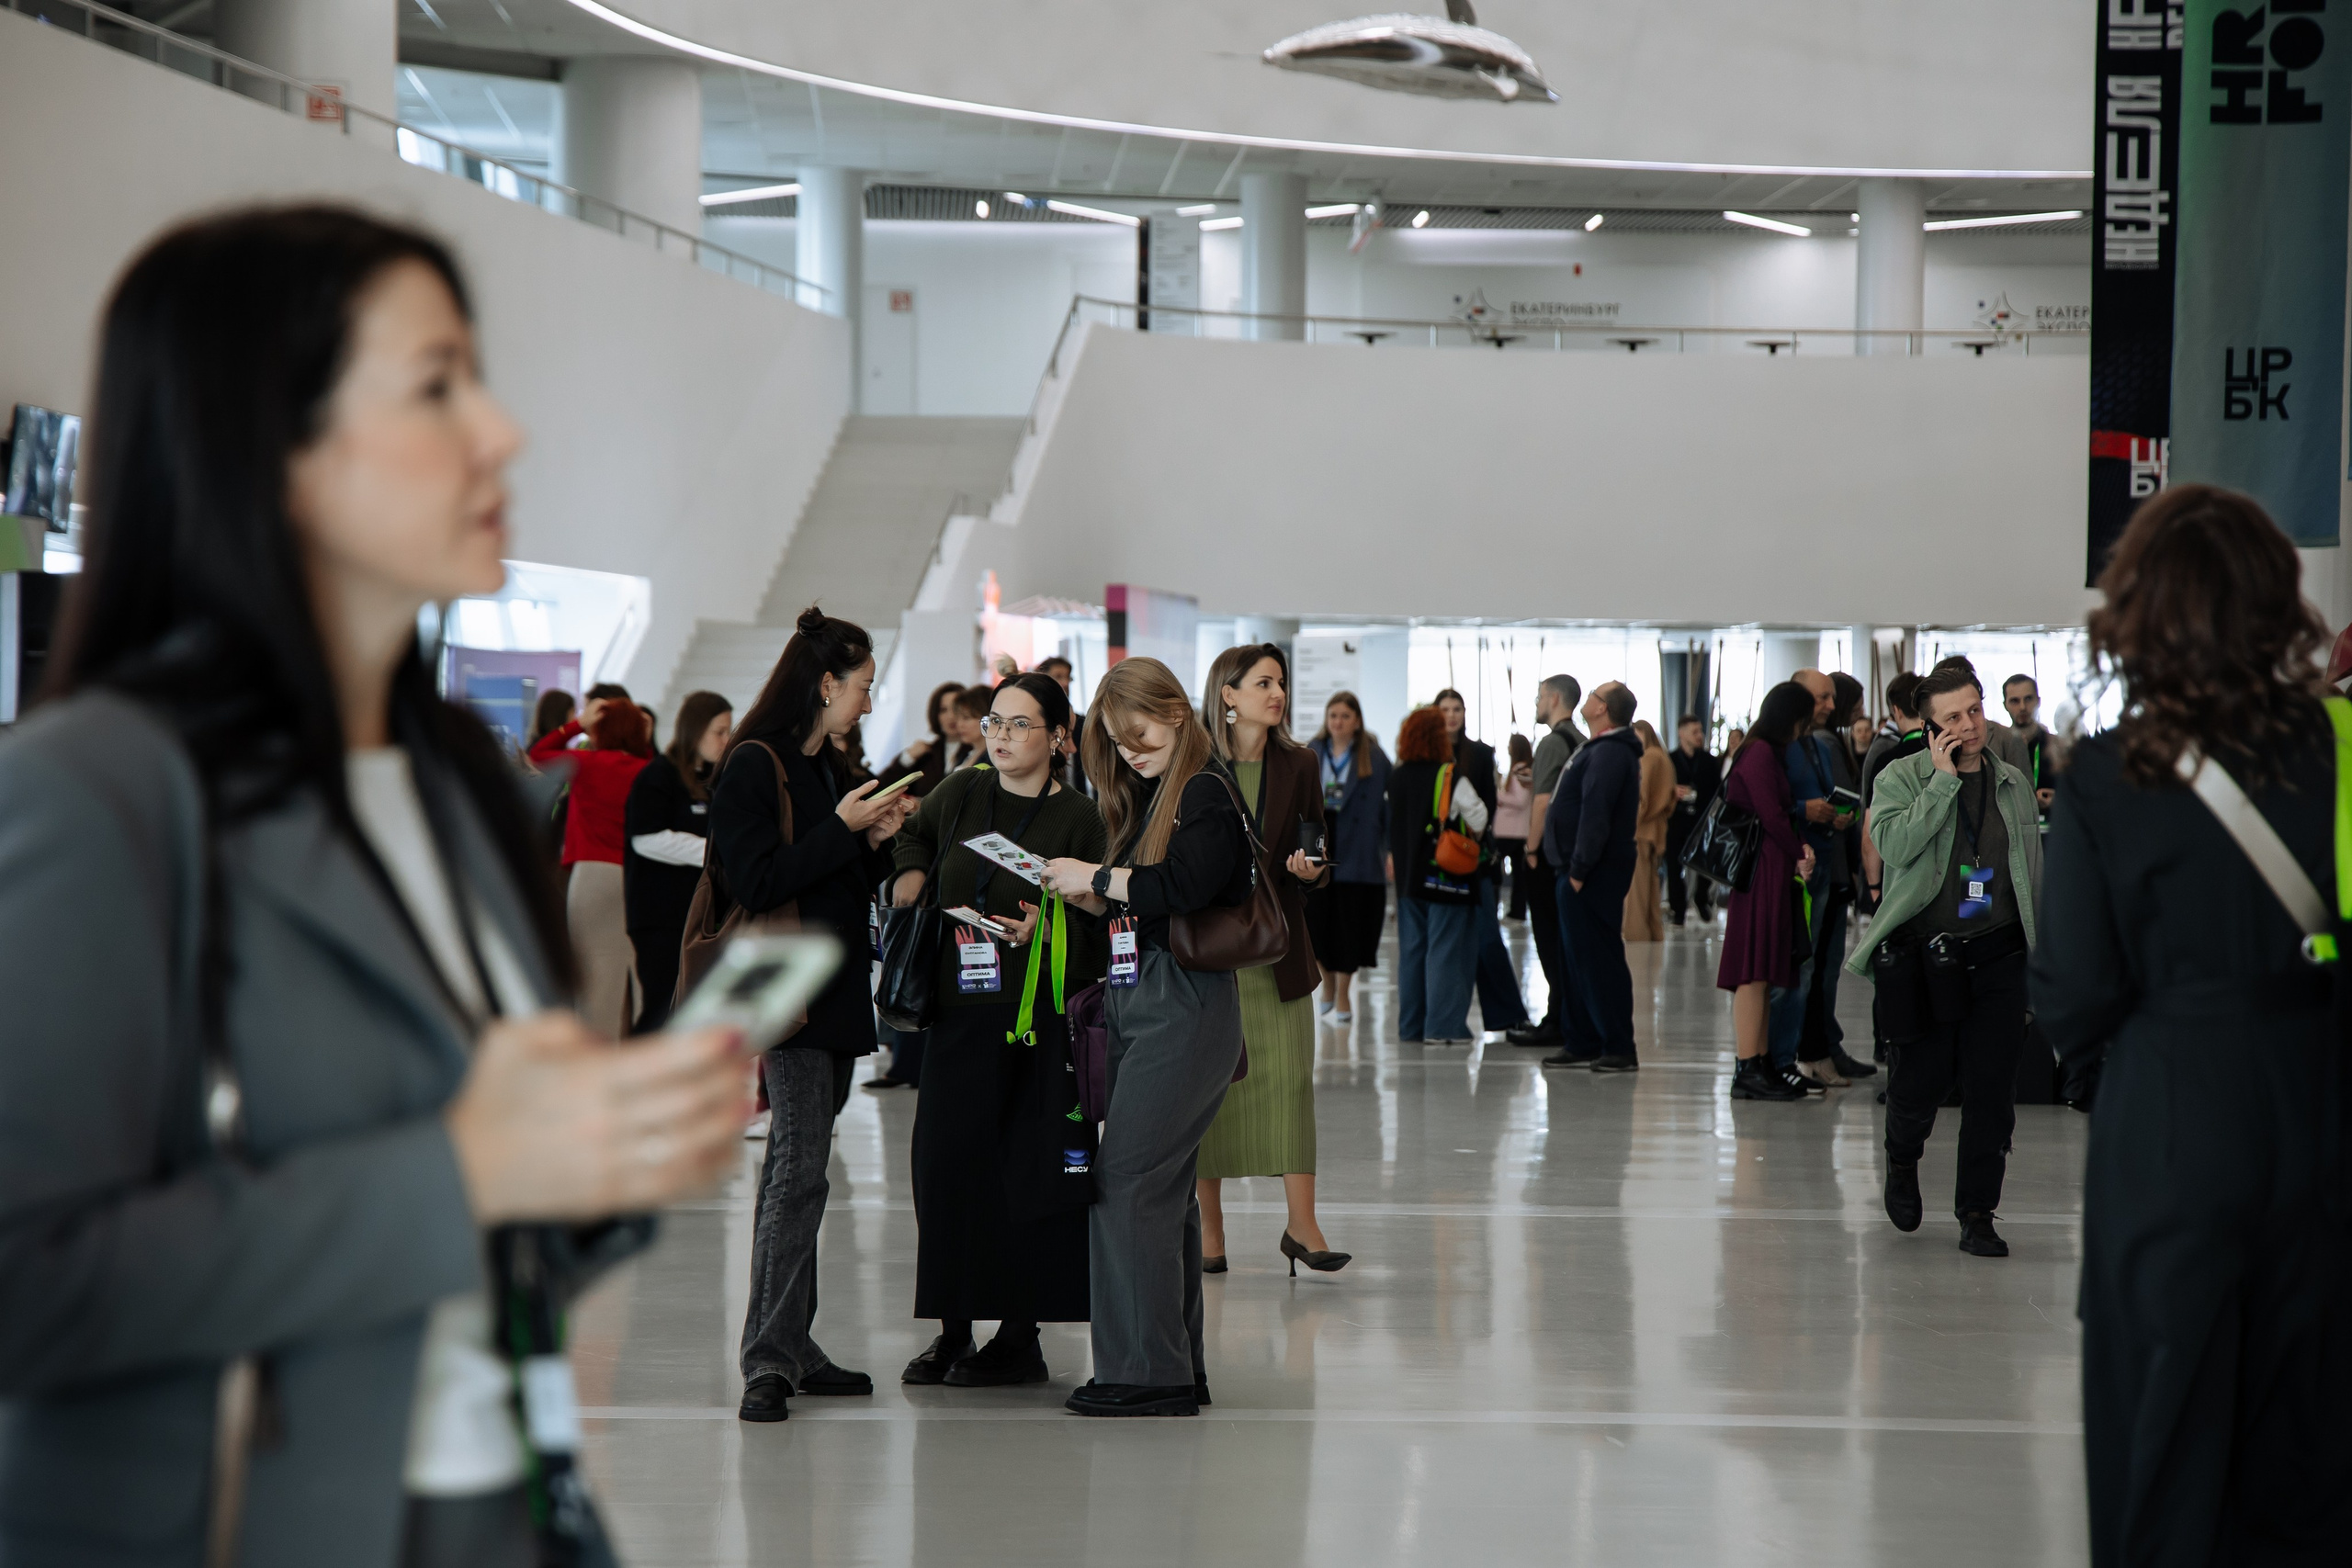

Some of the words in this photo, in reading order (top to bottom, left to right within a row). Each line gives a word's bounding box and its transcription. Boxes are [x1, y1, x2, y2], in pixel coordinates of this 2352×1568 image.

[2210, 3, 2266, 125] HR
[2104, 74, 2170, 262] НЕДЕЛЯ
[2223, 382, 2291, 422] БК
[2224, 346, 2293, 392] ЦР
